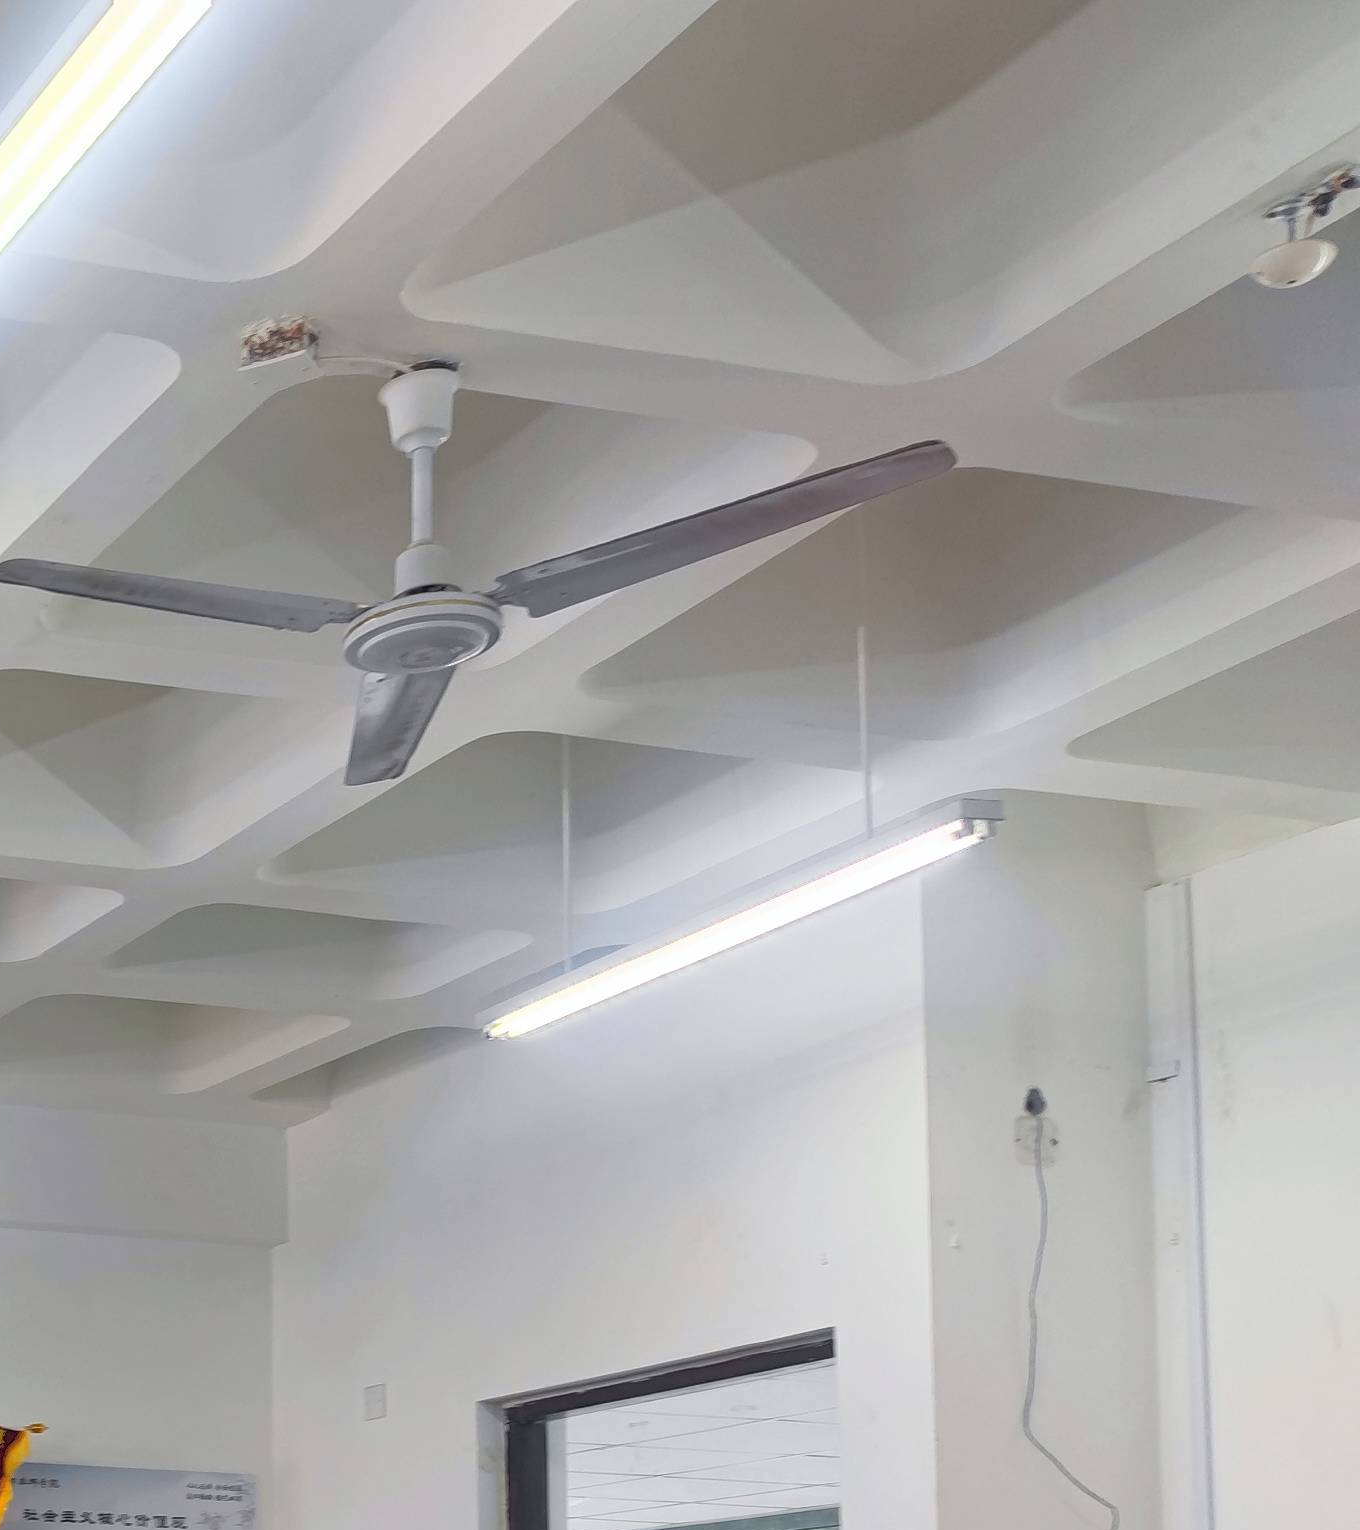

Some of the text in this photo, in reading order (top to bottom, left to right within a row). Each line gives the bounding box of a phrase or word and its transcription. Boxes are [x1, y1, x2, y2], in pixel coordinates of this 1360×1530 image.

[22, 1509, 189, 1529] 社会主义核心价值观
